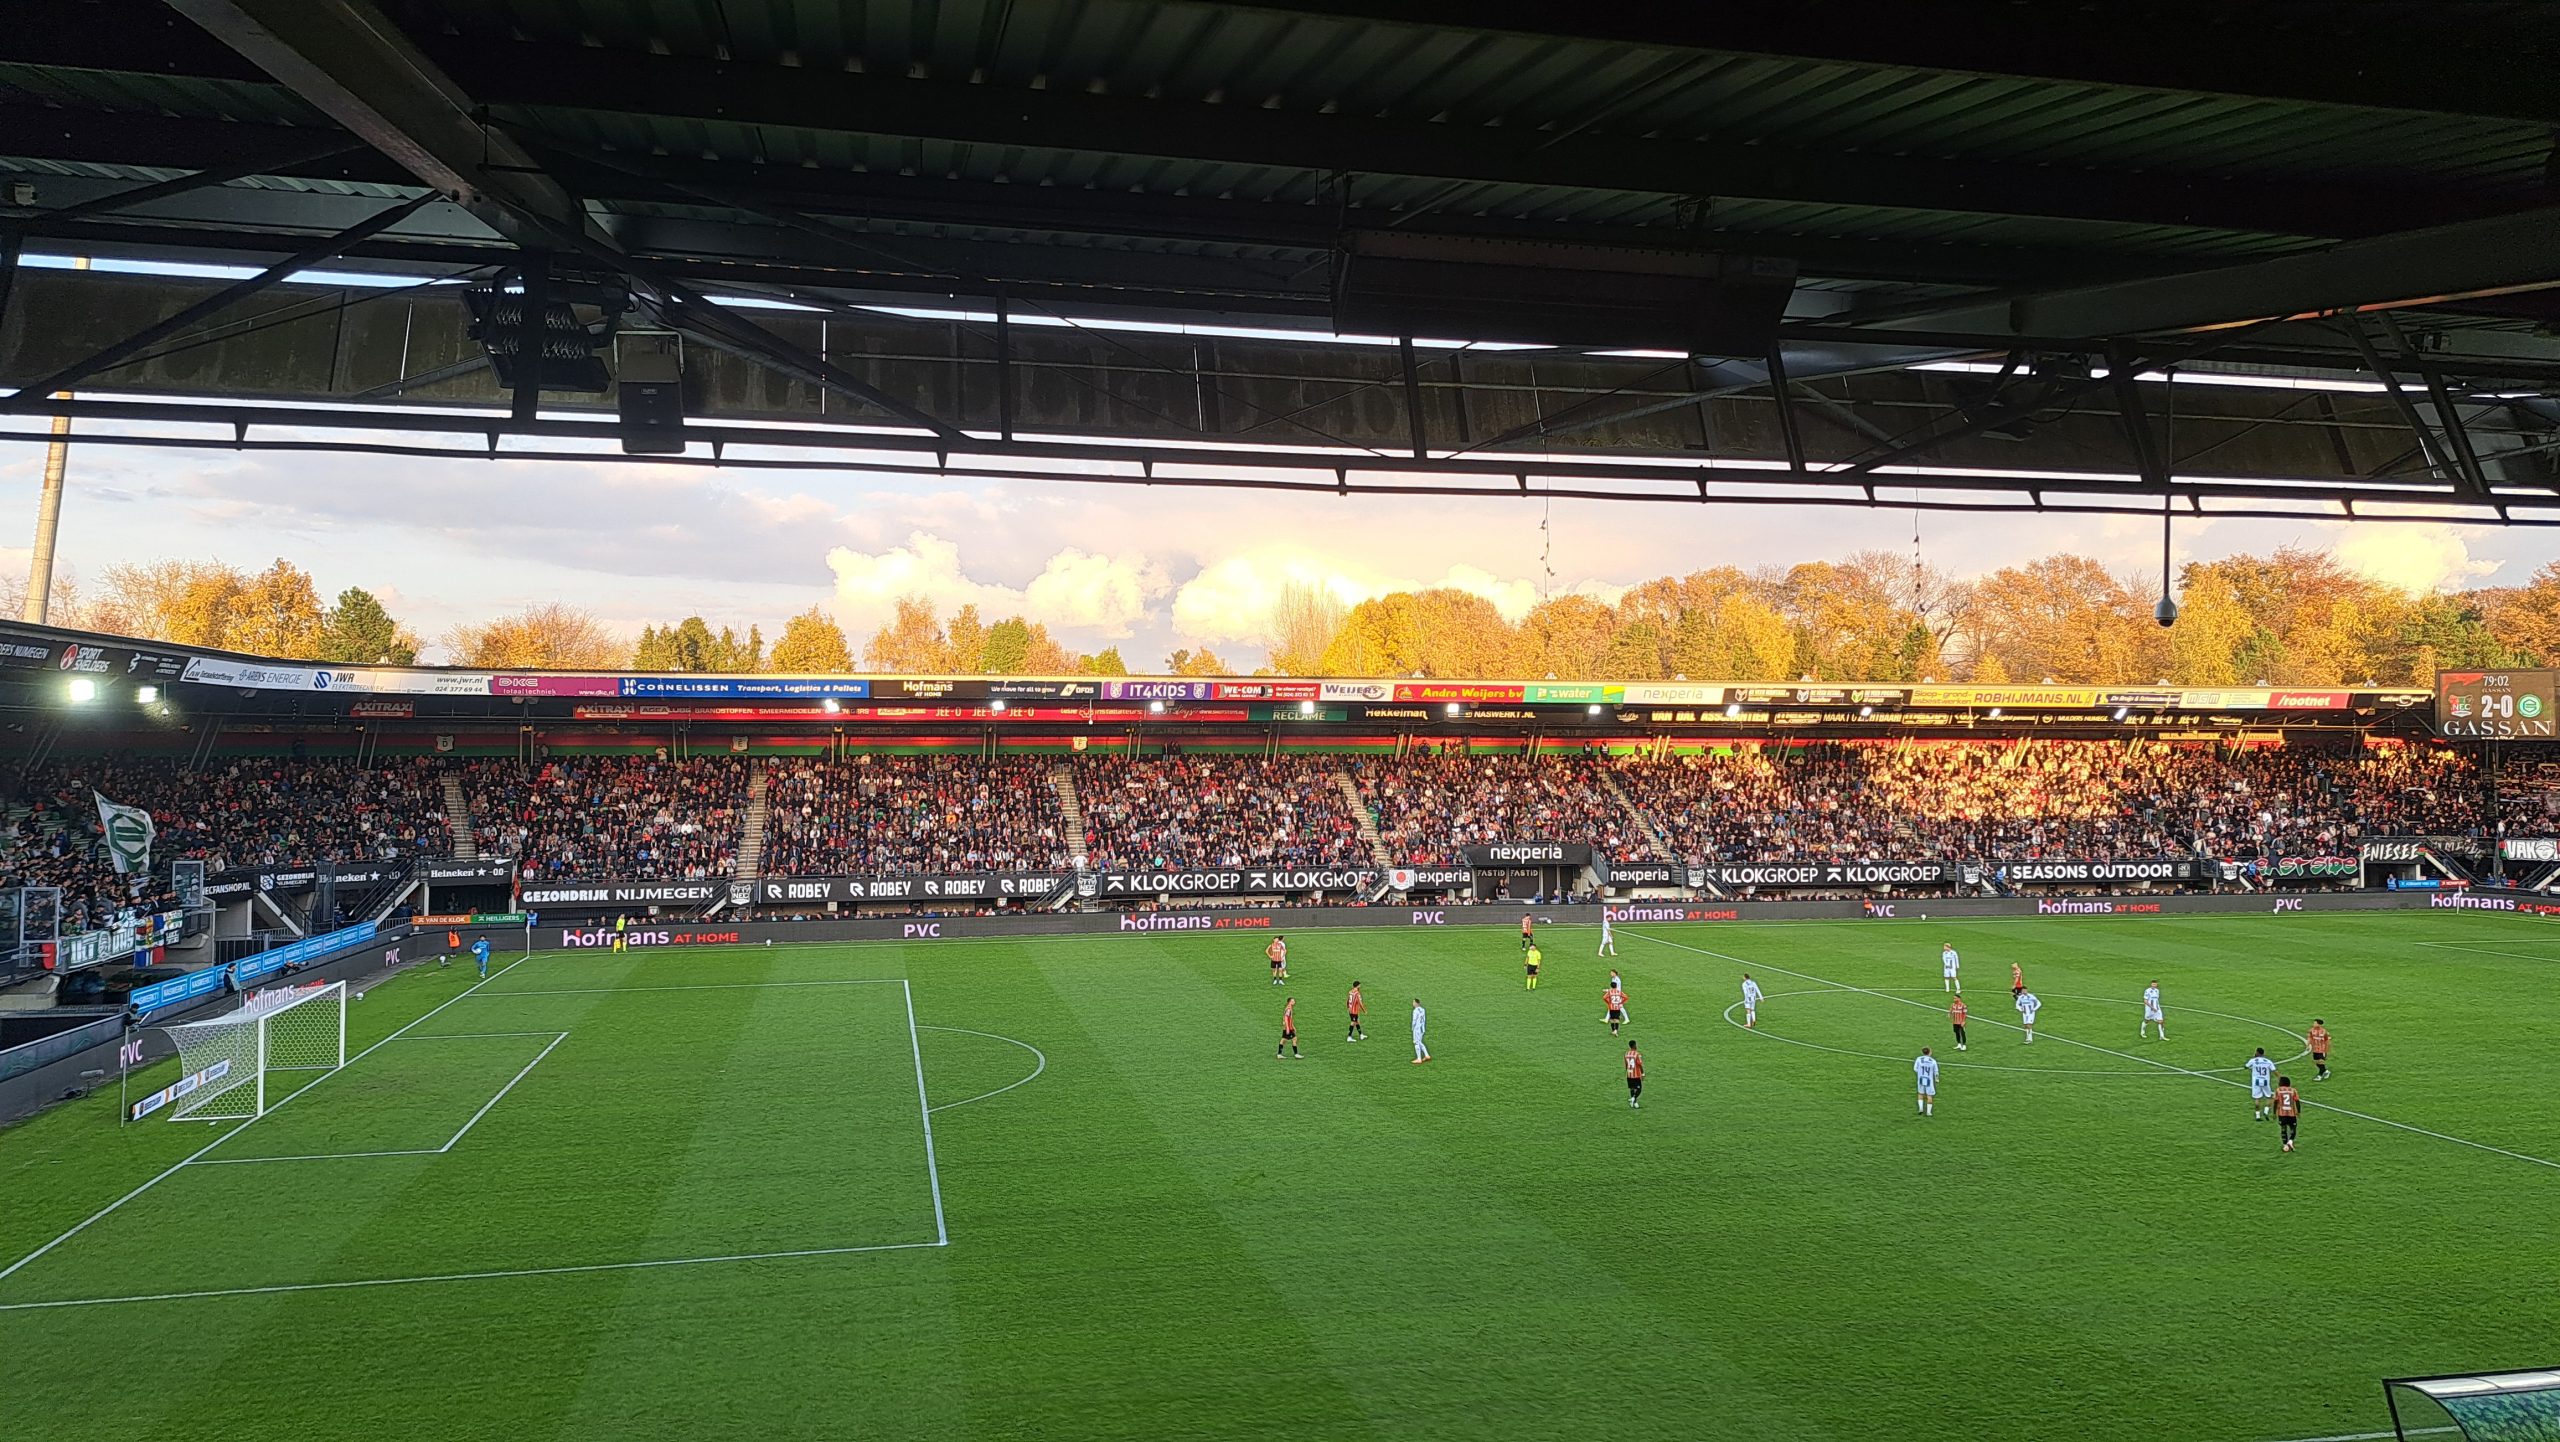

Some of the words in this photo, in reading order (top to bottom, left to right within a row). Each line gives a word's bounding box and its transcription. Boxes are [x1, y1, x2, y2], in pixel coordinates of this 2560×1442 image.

[76, 647, 104, 660] SPORT
[266, 673, 303, 685] ENERGIE
[334, 672, 355, 683] JWR
[437, 676, 483, 684] www.jwr.nl
[2482, 675, 2510, 687] 79:02
[737, 684, 782, 693] Transport,
[784, 684, 821, 693] Logistics
[832, 684, 862, 692] Pallets
[903, 681, 953, 692] Hofmans
[1129, 684, 1186, 698] IT4KIDS
[1225, 686, 1262, 694] WE-COM
[1508, 688, 1524, 698] bv
[1643, 688, 1703, 702] nexperia
[1974, 692, 2083, 705] ROBHIJMANS.NL
[2452, 703, 2471, 712] NEC
[1272, 711, 1326, 721] RECLAME
[2443, 720, 2552, 737] GASSAN
[1490, 844, 1563, 864] nexperia
[276, 872, 315, 881] GEZONDRIJK
[430, 868, 474, 878] Heineken
[1610, 868, 1669, 885] nexperia
[1721, 867, 1818, 884] KLOKGROEP
[1846, 866, 1941, 883] KLOKGROEP
[2012, 864, 2088, 879] SEASONS
[2092, 863, 2172, 879] OUTDOOR
[944, 880, 986, 894] ROBEY
[1019, 878, 1060, 893] ROBEY
[1130, 873, 1241, 891] KLOKGROEP
[788, 883, 831, 898] ROBEY
[870, 881, 912, 896] ROBEY
[522, 888, 609, 903] GEZONDRIJK
[615, 887, 713, 900] NIJMEGEN
[2115, 905, 2128, 913] AT
[2130, 904, 2160, 913] HOME
[2275, 898, 2302, 910] PVC
[2518, 904, 2532, 912] AT
[1412, 911, 1445, 925] PVC
[1687, 910, 1702, 920] AT
[1704, 910, 1737, 920] HOME
[1215, 918, 1231, 928] AT
[1234, 917, 1271, 927] HOME
[904, 923, 941, 938] PVC
[673, 934, 692, 944] AT
[696, 932, 739, 944] HOME
[385, 947, 400, 967] PVC
[119, 1039, 143, 1068] PVC
[1921, 1066, 1931, 1076] 14
[2255, 1066, 2267, 1076] 43
[2283, 1094, 2290, 1105] 2
